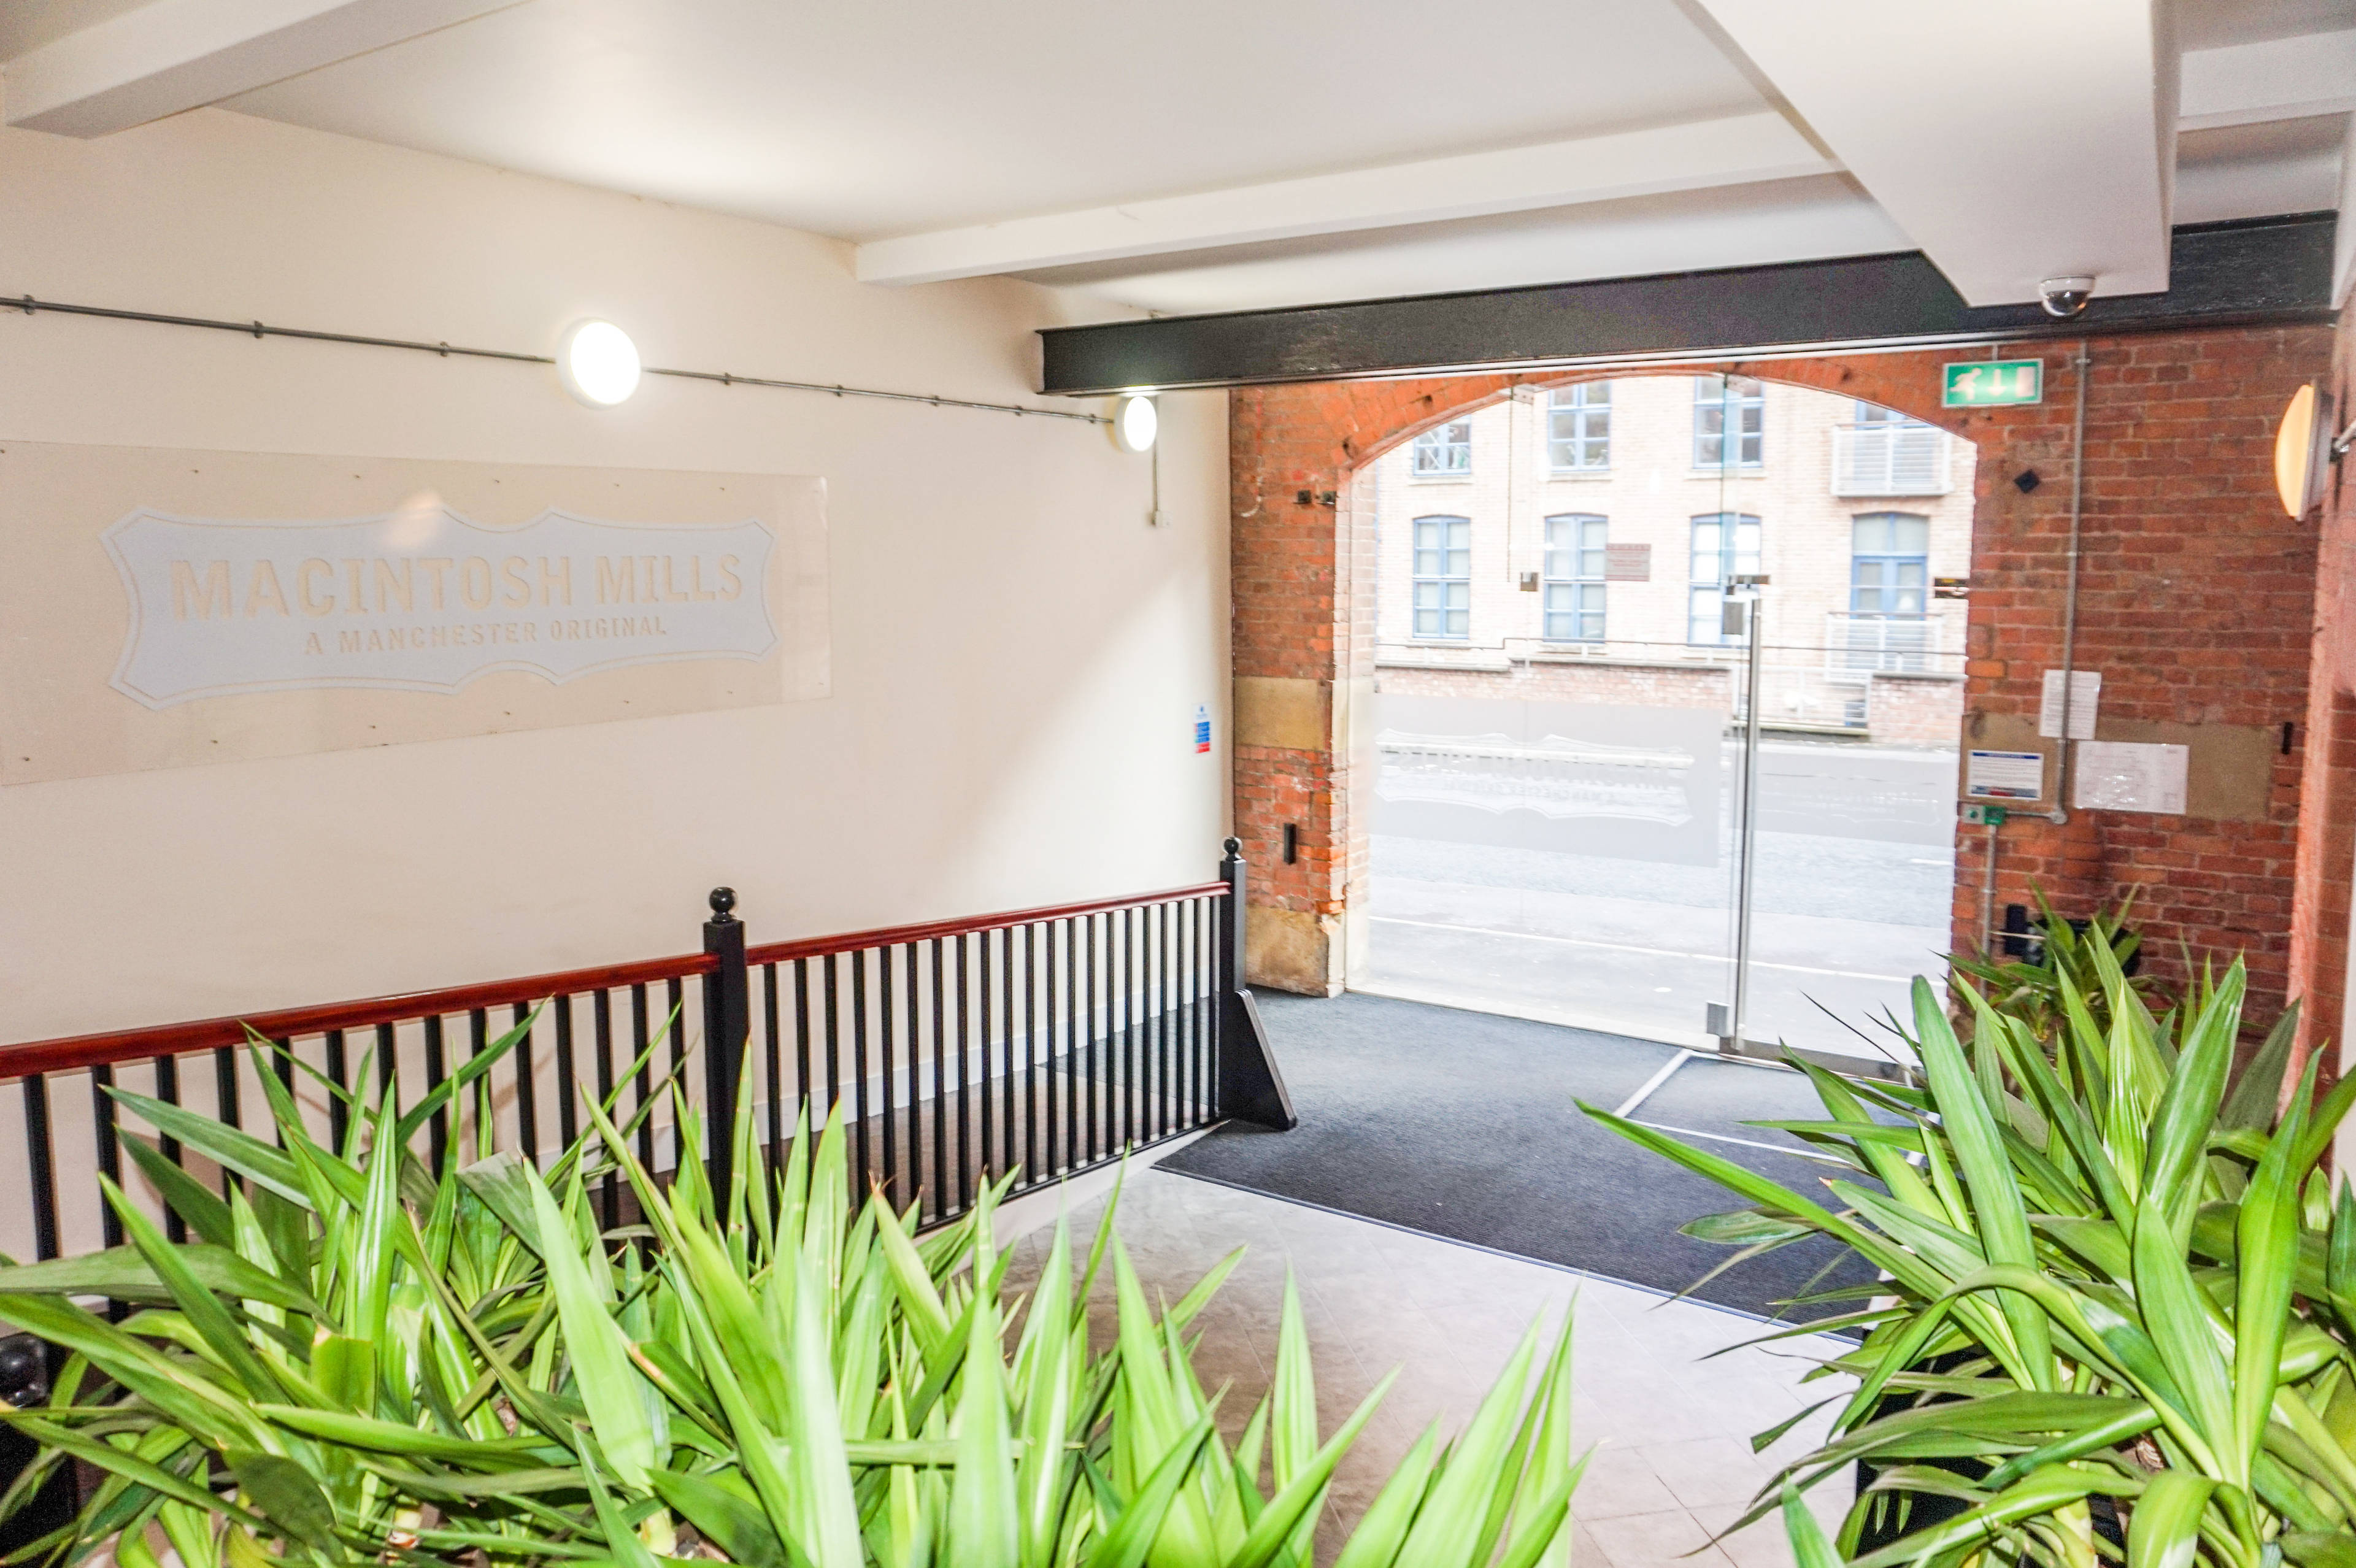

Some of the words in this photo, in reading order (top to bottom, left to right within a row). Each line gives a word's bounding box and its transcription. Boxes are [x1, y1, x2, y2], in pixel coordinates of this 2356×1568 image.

[171, 555, 572, 620] MACINTOSH
[595, 553, 742, 605] MILLS
[305, 631, 323, 654] A
[339, 622, 537, 653] MANCHESTER
[550, 616, 668, 640] ORIGINAL
